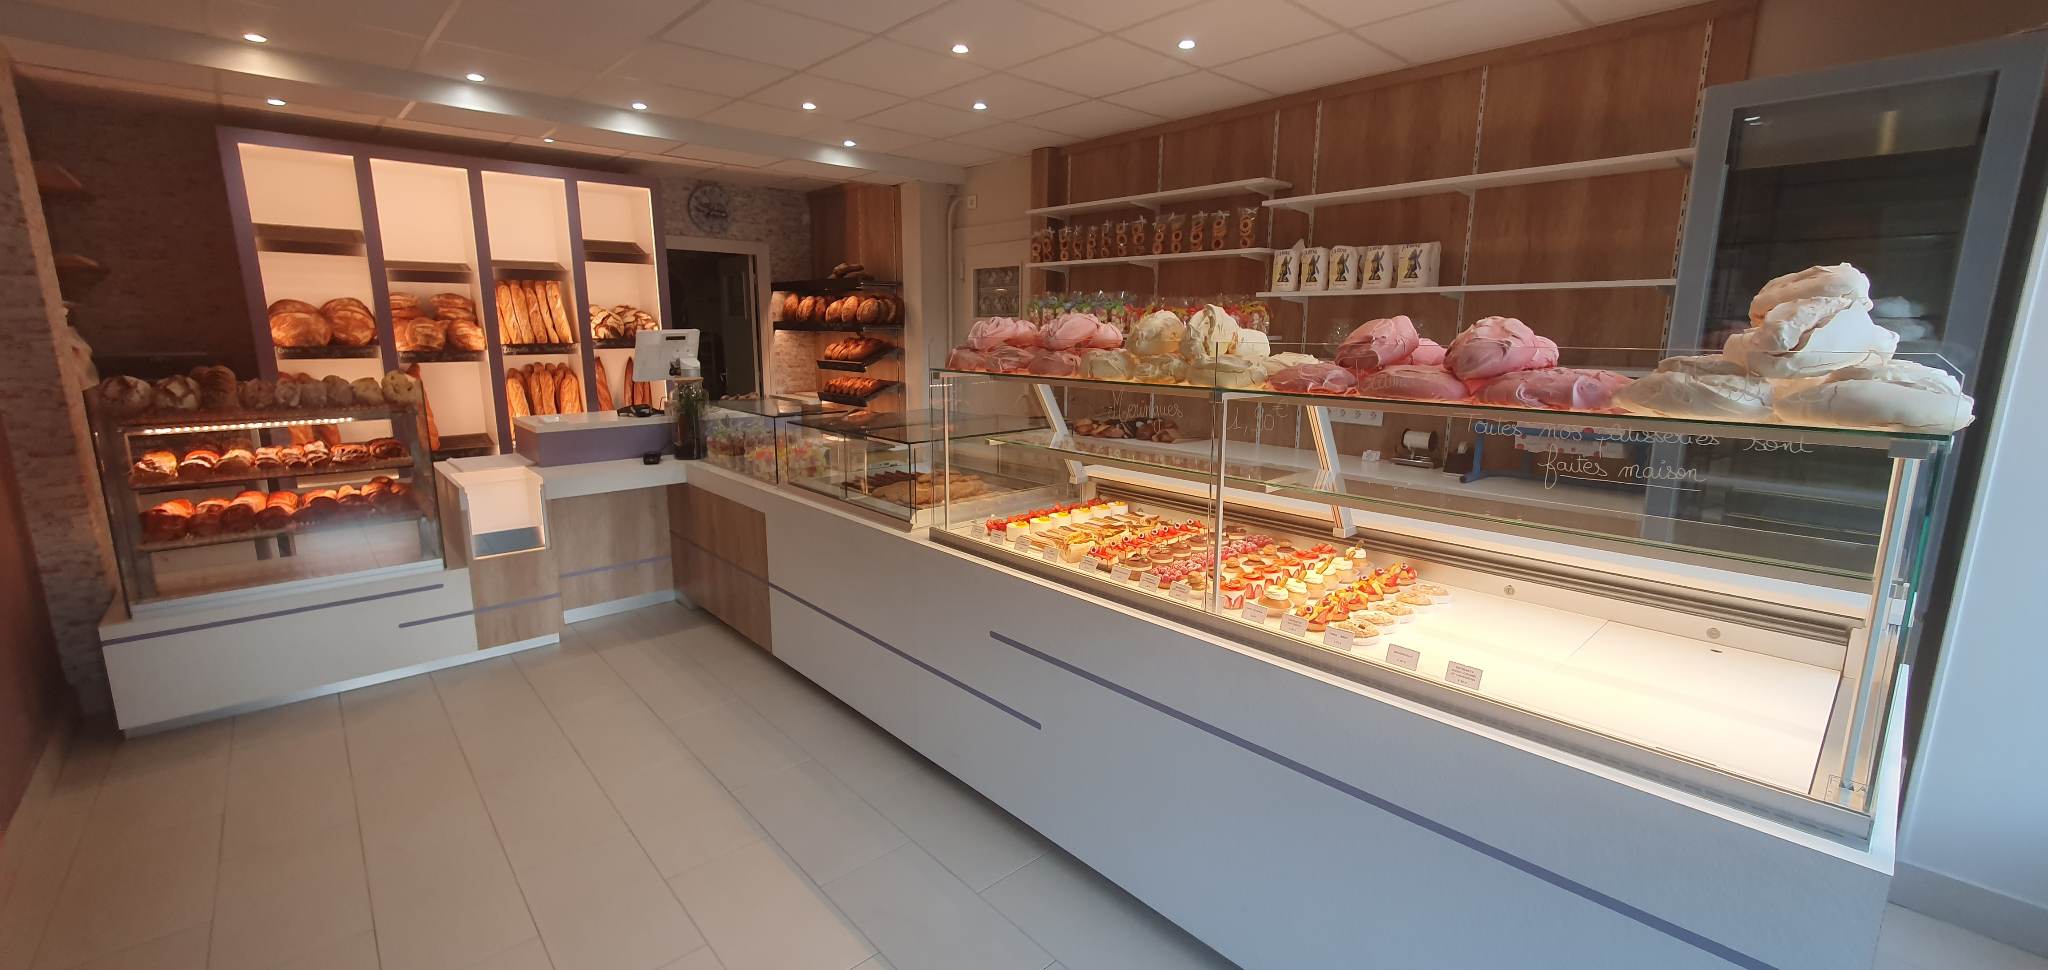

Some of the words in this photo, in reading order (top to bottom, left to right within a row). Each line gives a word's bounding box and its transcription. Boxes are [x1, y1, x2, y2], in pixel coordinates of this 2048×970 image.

[1538, 424, 1583, 441] nos
[1743, 432, 1814, 453] sont
[1537, 443, 1608, 489] faites
[1617, 459, 1707, 482] maison
